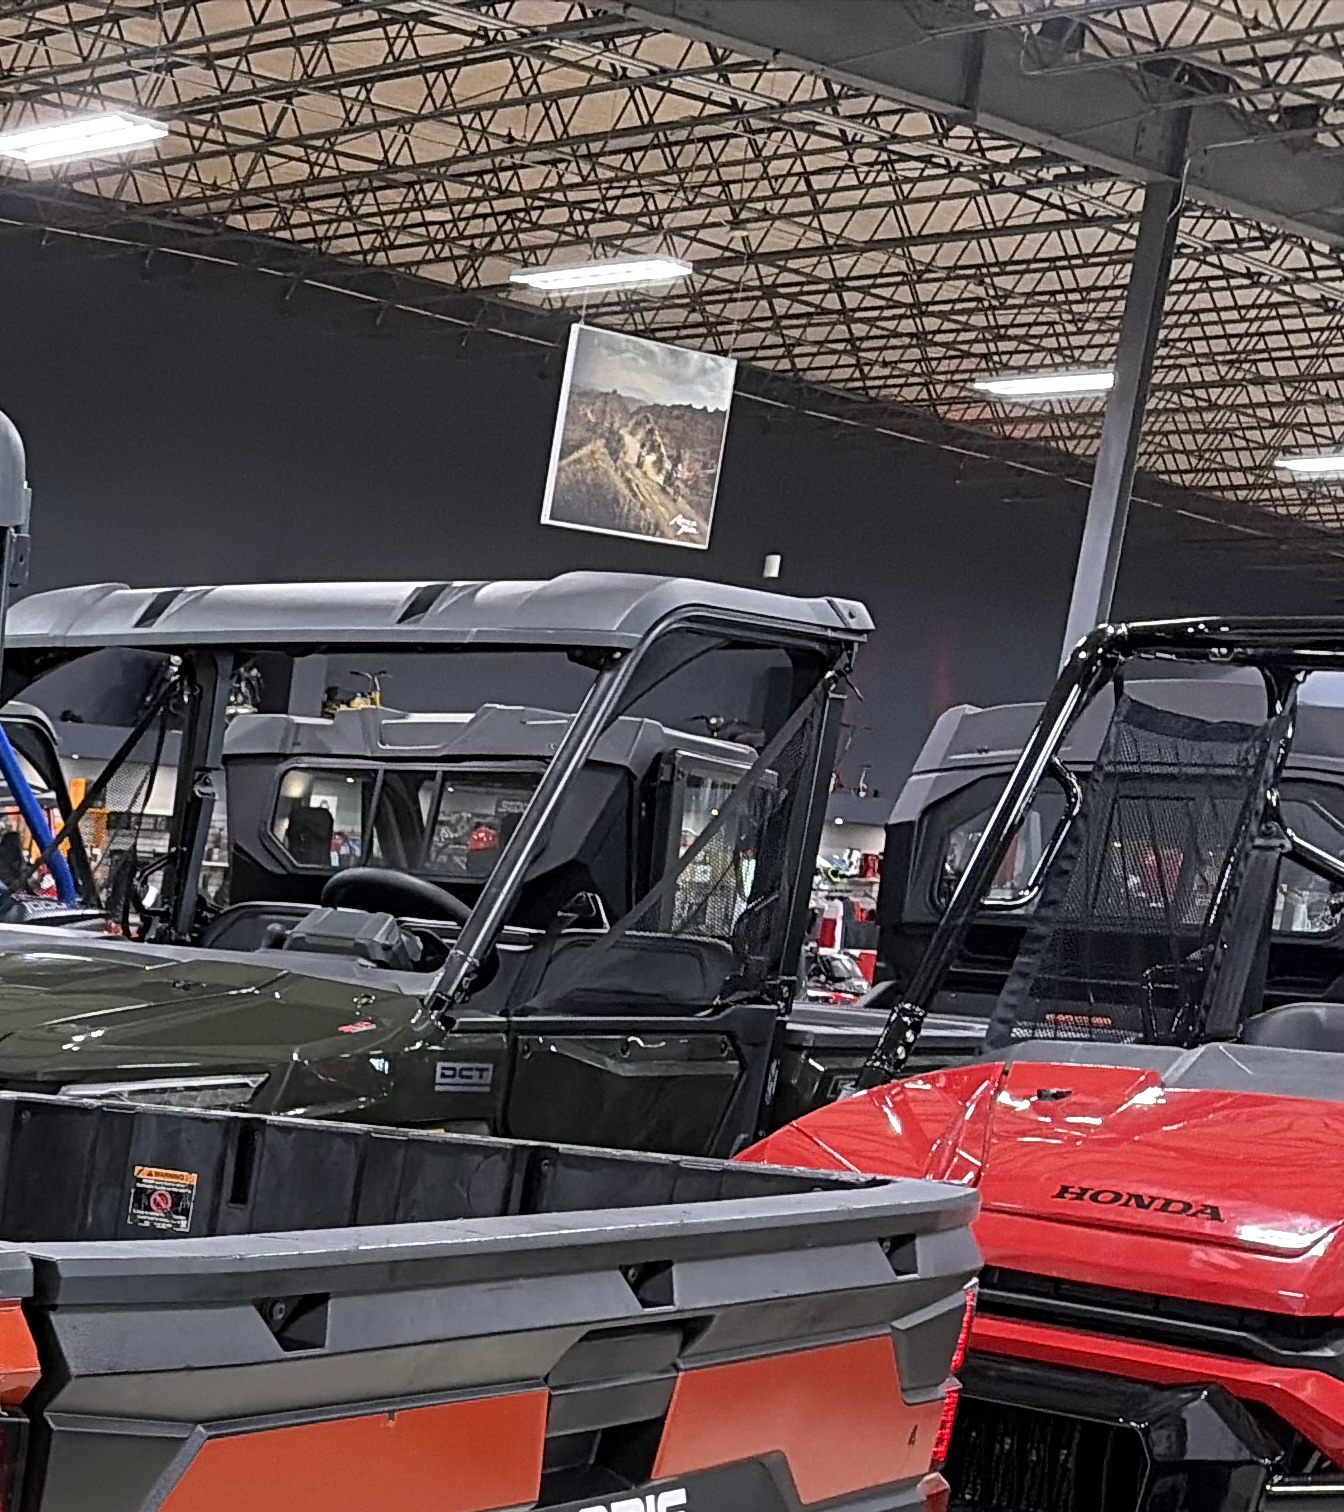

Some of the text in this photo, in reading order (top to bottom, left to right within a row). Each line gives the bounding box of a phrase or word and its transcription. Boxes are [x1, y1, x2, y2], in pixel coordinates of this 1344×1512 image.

[440, 1066, 489, 1079] DCT
[154, 1170, 185, 1181] WARNING
[1052, 1184, 1225, 1222] HONDA
